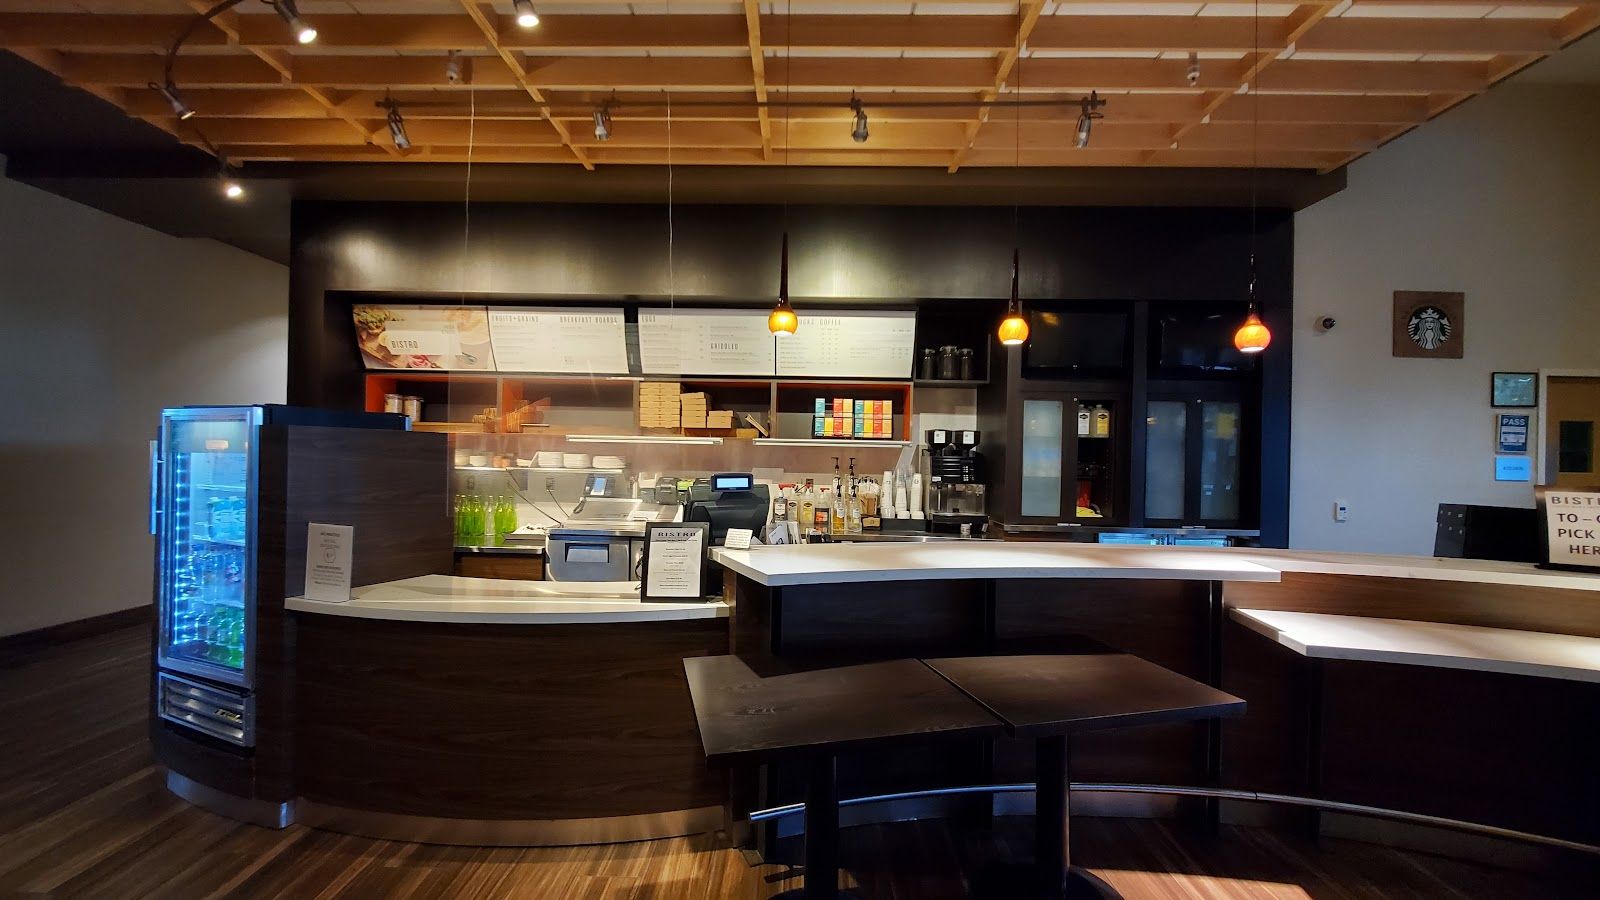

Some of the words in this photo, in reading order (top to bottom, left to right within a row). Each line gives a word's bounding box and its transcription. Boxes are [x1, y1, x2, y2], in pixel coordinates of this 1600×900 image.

[391, 340, 418, 349] BISTRO
[1503, 418, 1526, 426] PASS
[1557, 528, 1595, 539] PICK
[1569, 544, 1600, 555] HER
